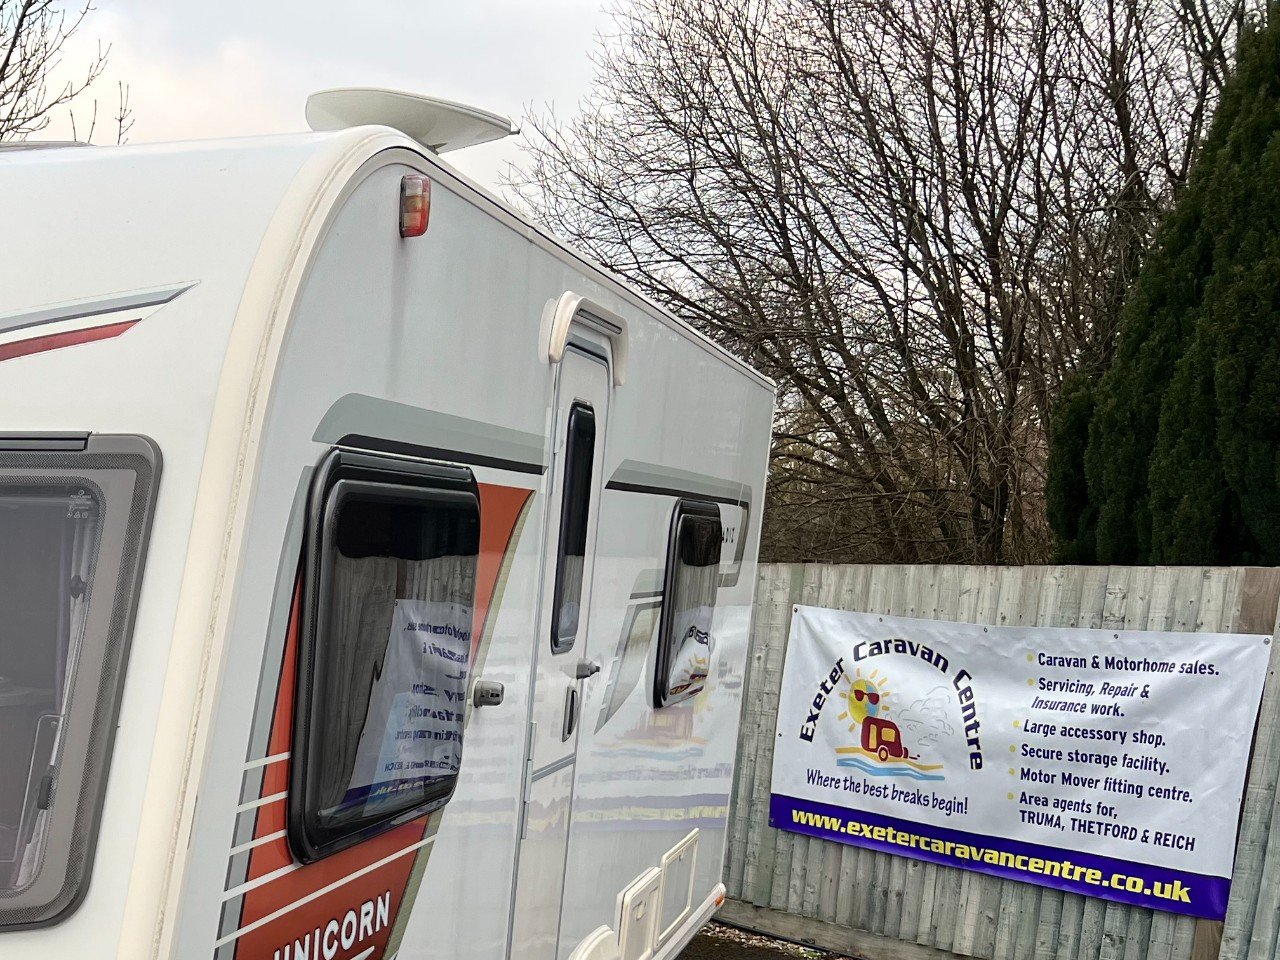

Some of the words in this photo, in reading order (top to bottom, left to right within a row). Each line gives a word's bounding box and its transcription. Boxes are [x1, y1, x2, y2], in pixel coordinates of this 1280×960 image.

[1038, 652, 1087, 669] Caravan
[1091, 655, 1100, 669] &
[1104, 656, 1176, 673] Motorhome
[1178, 660, 1220, 676] sales.
[1038, 677, 1096, 697] Servicing,
[1099, 681, 1138, 698] Repair
[1140, 684, 1150, 698] &
[799, 657, 845, 743] Exeter
[853, 638, 949, 673] Caravan
[953, 669, 983, 770] Centre
[1031, 696, 1087, 713] Insurance
[1090, 702, 1125, 717] work.
[1023, 719, 1056, 737] Large
[1060, 726, 1127, 745] accessory
[1132, 730, 1166, 748] shop.
[1021, 743, 1063, 761] Secure
[1067, 749, 1118, 768] storage
[1121, 753, 1170, 775] facility.
[807, 768, 840, 790] Where
[843, 776, 861, 793] the
[863, 779, 889, 799] best
[891, 784, 929, 807] breaks
[932, 792, 968, 816] begin!
[1020, 767, 1056, 784] Motor
[1061, 772, 1100, 789] Mover
[1103, 777, 1143, 798] fitting
[1148, 785, 1193, 803] centre.
[1019, 791, 1049, 807] Area
[1053, 798, 1092, 814] agents
[1096, 801, 1118, 819] for,
[1019, 809, 1065, 832] TRUMA,
[1070, 818, 1137, 841] THETFORD
[1140, 829, 1150, 843] &
[1153, 831, 1196, 851] REICH
[792, 808, 1192, 904] www.exetercaravancentre.co.uk
